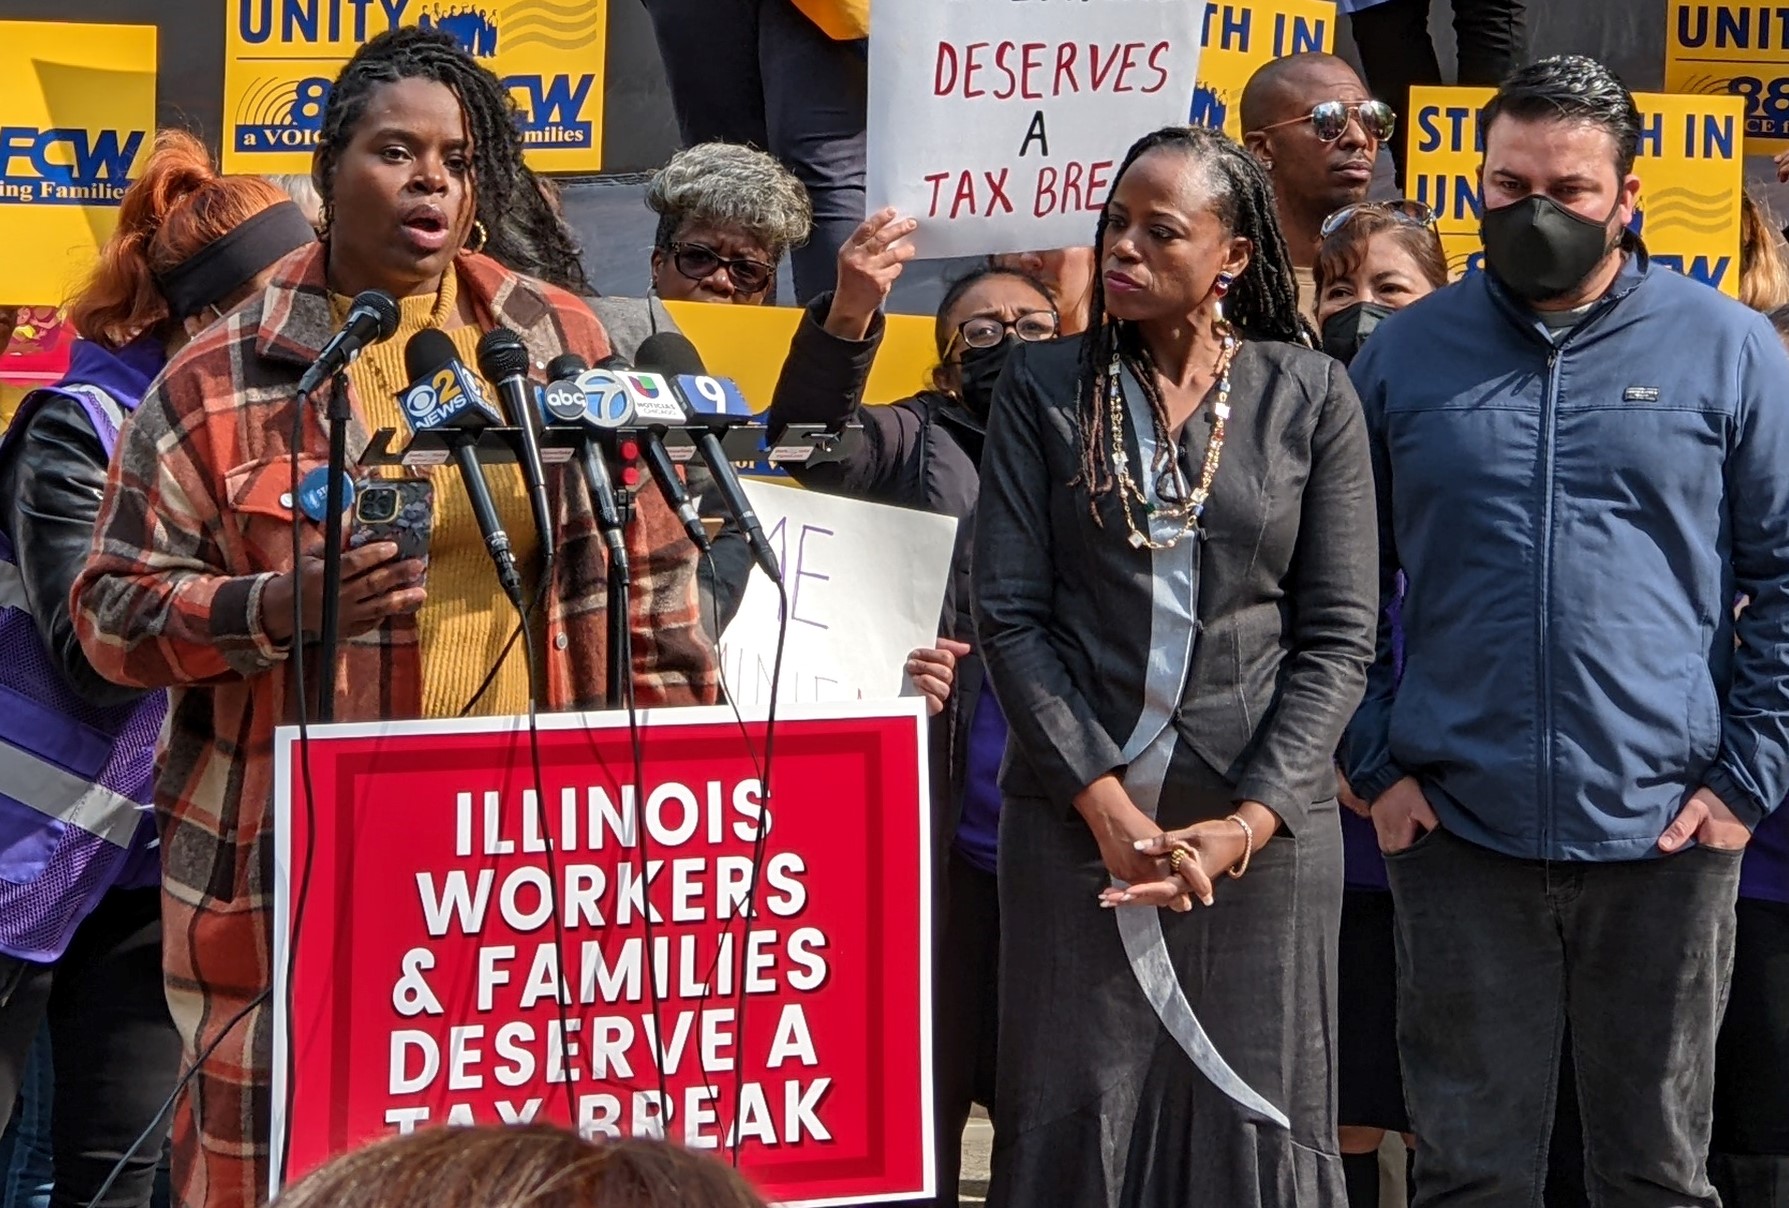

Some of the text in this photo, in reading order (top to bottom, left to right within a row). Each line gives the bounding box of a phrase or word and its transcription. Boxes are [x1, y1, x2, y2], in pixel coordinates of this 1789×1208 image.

[239, 0, 408, 43] UNITY
[1272, 12, 1325, 57] IN
[934, 41, 1169, 99] DESERVES
[243, 133, 257, 146] a
[1018, 110, 1049, 157] A
[1685, 114, 1733, 159] IN
[924, 167, 1014, 219] TAX
[432, 369, 462, 405] 2
[547, 389, 586, 408] abc
[695, 376, 726, 414] 9
[415, 394, 467, 429] NEWS
[456, 778, 773, 857] ILLINOIS
[416, 852, 807, 936] WORKERS
[392, 927, 829, 1016] & FAMILIES
[388, 1004, 819, 1095] DESERVE A
[577, 1077, 833, 1150] BREAK
